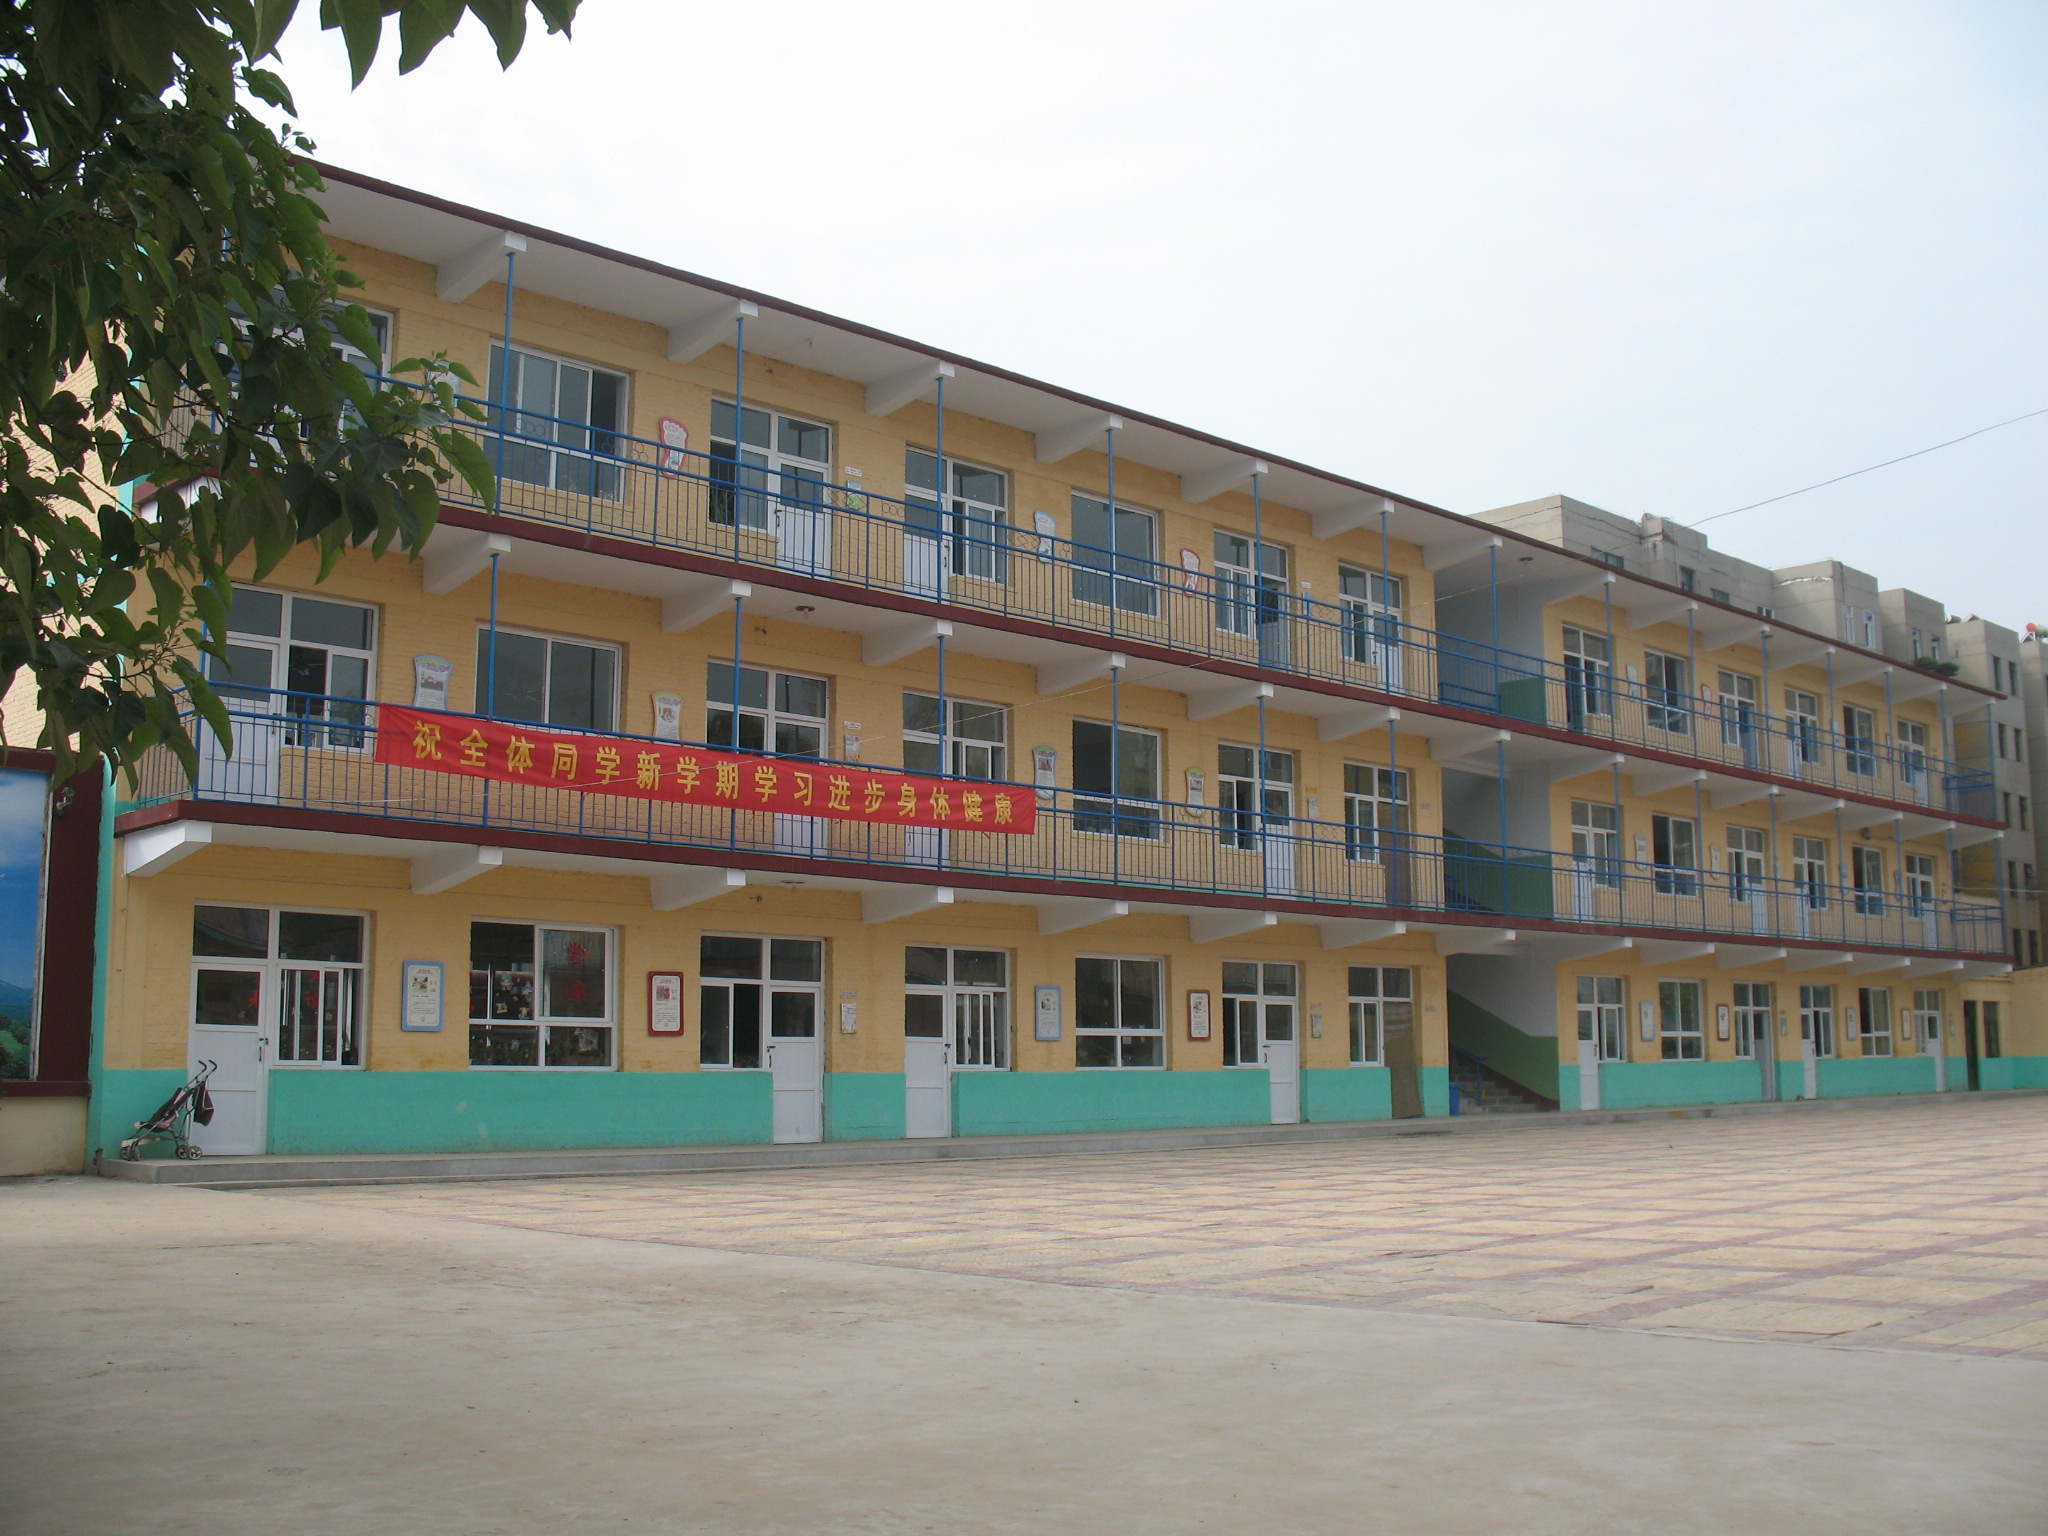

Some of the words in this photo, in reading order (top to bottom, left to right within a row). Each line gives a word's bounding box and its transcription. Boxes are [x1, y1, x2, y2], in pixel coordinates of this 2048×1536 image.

[412, 720, 1013, 824] 祝全体同学新学期学习进步身体健康
